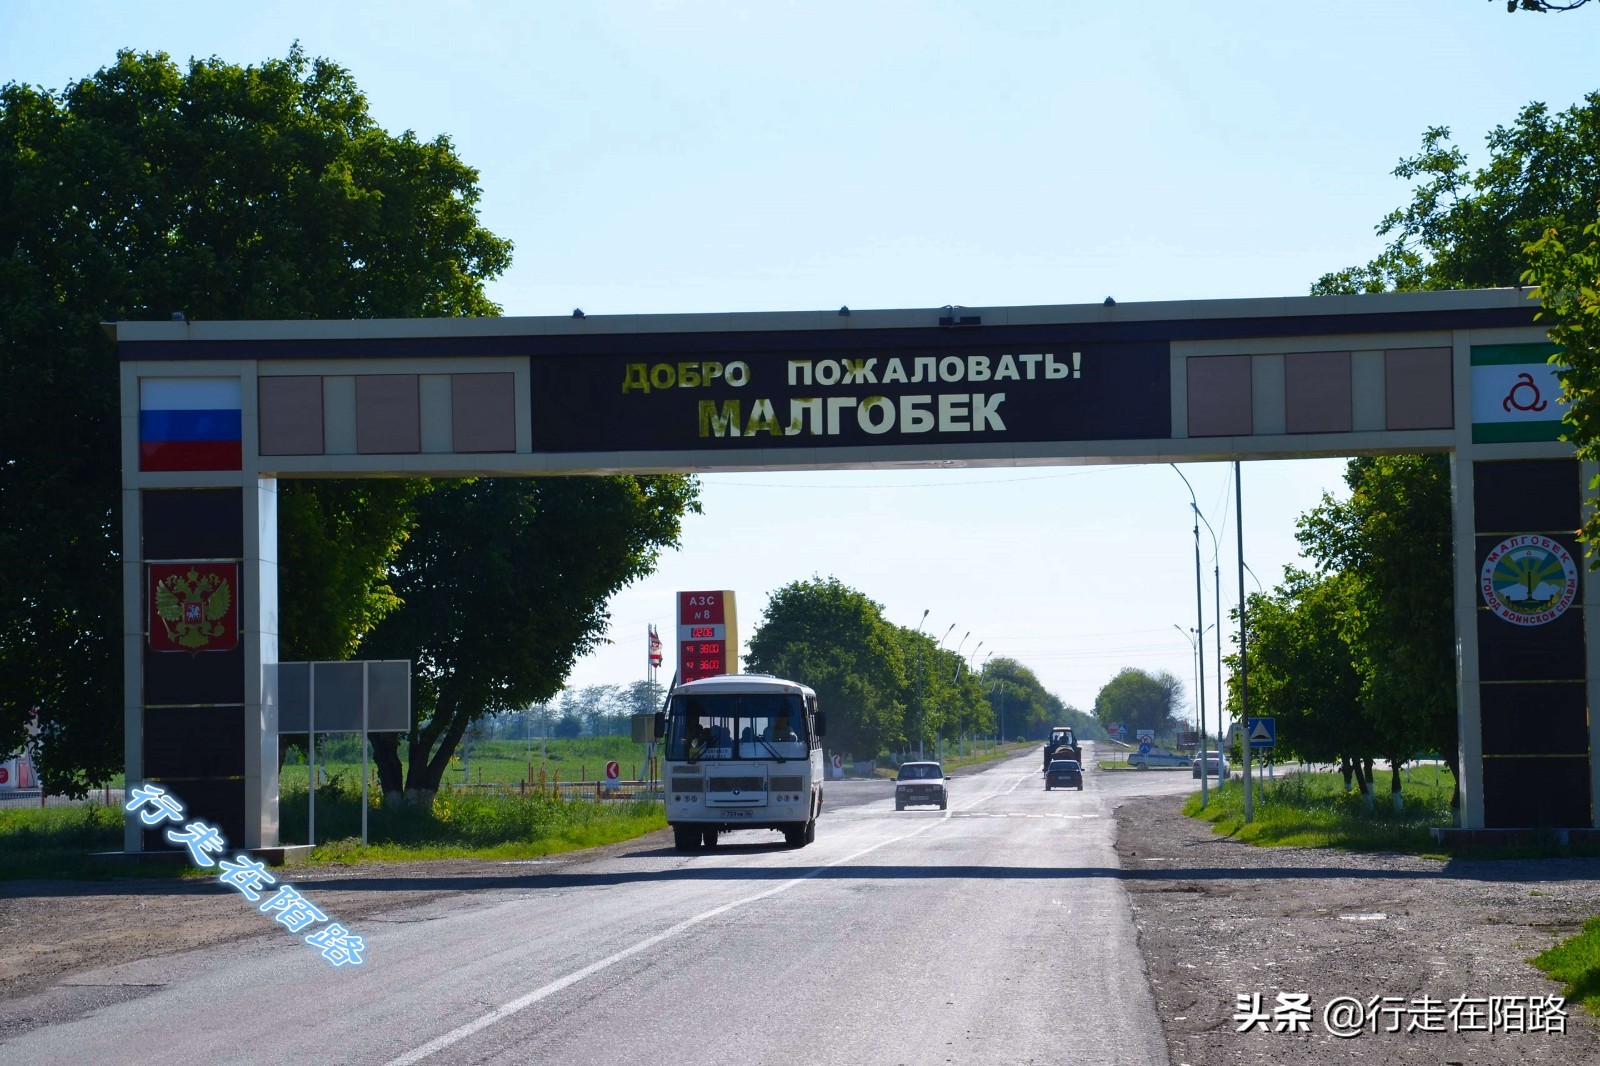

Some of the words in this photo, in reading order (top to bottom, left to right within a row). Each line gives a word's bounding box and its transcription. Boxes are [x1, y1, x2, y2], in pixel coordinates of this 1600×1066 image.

[622, 360, 750, 394] ДОБРО
[787, 352, 1082, 386] ПОЖАЛОВАТЬ!
[698, 393, 1007, 437] МАЛГОБЕК
[1487, 536, 1570, 564] МАЛГОБЕК
[689, 596, 715, 606] АЗС
[1483, 577, 1501, 612] ГОРОД
[1556, 578, 1575, 612] СЛАВЫ
